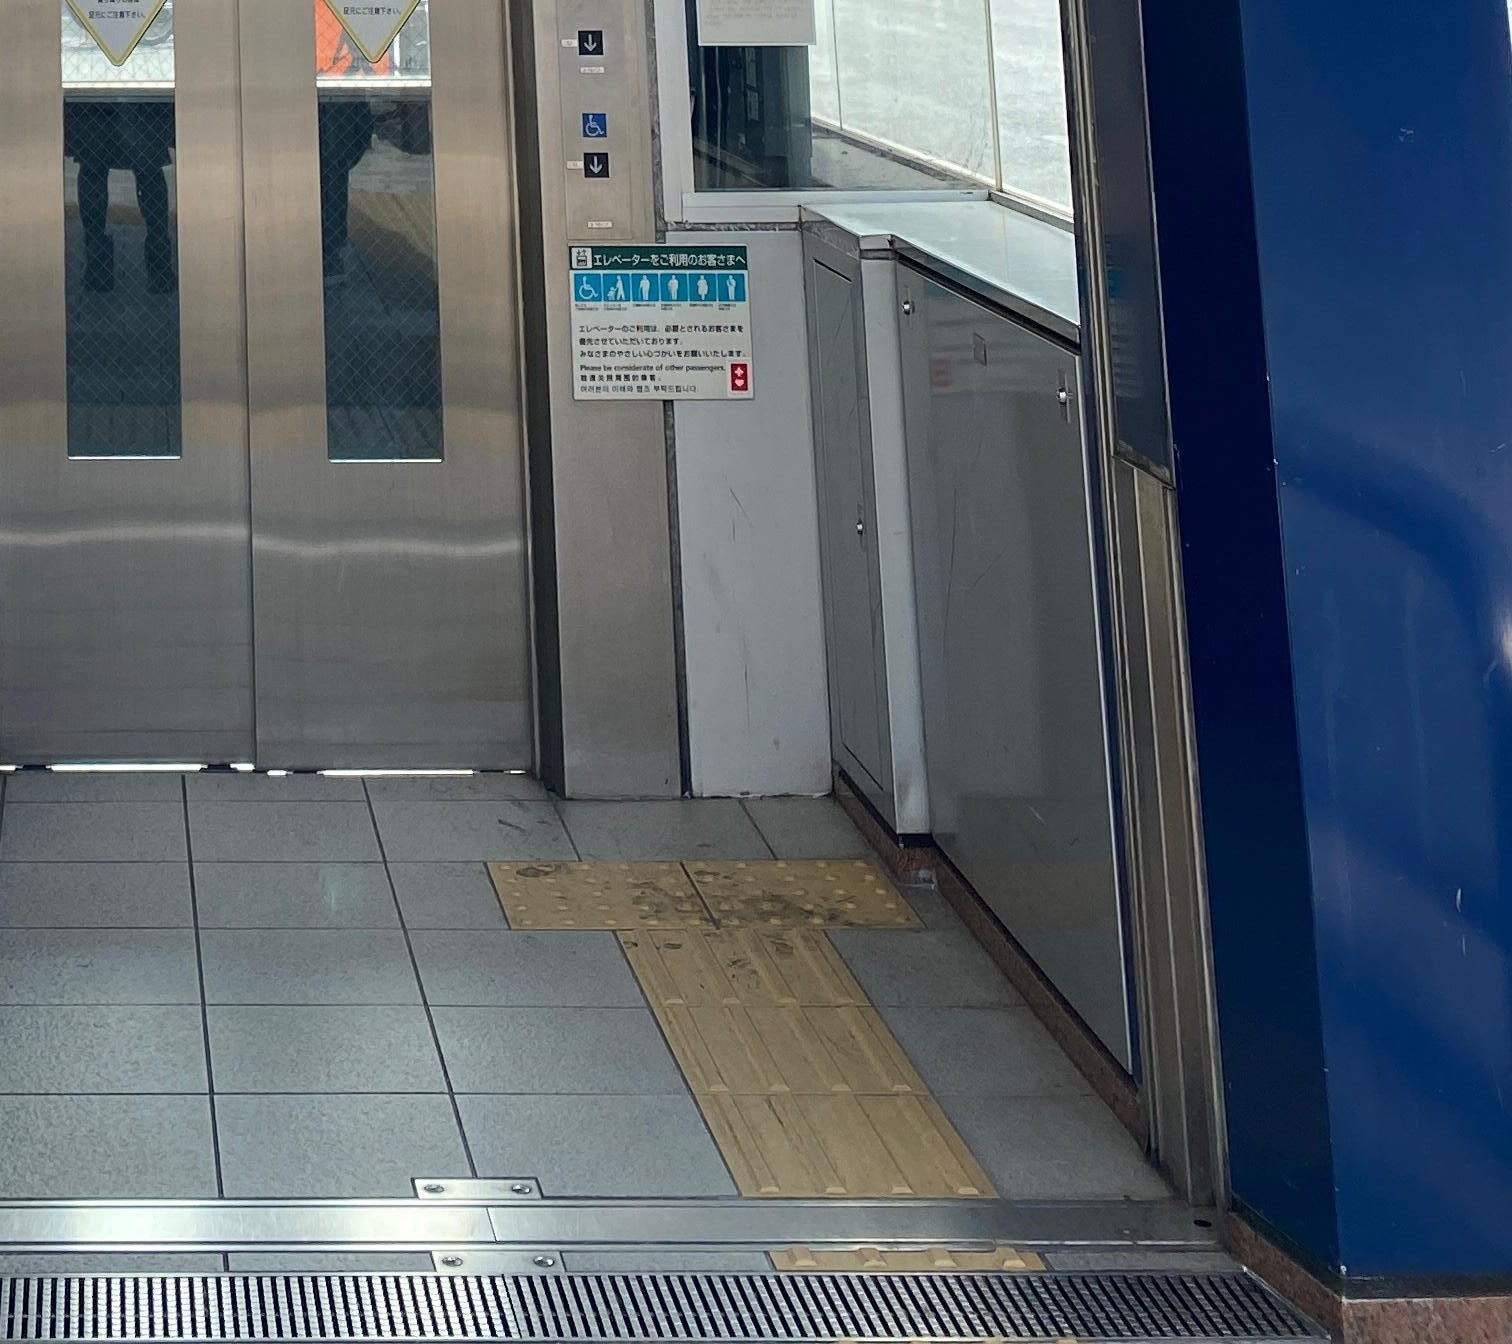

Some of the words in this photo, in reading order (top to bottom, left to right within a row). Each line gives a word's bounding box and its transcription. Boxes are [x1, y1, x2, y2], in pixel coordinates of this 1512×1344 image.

[593, 254, 746, 267] エレベーターをご利用のお客さまへ
